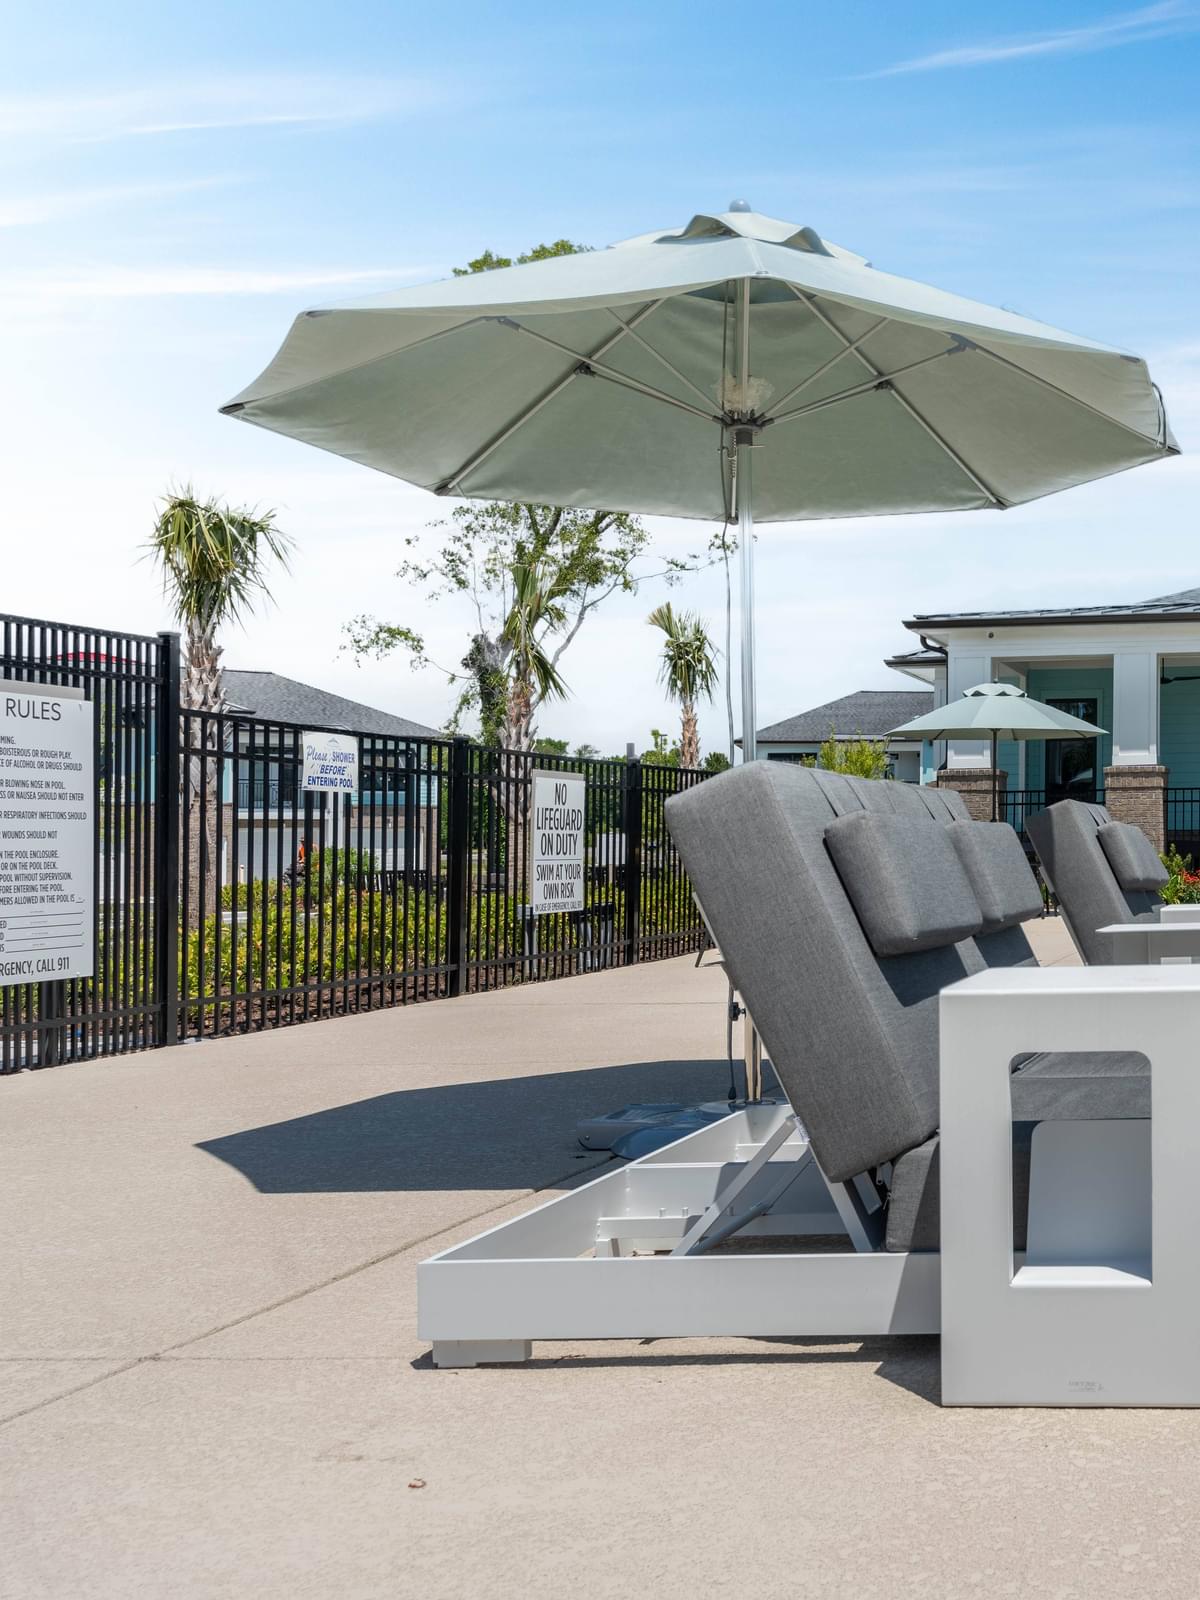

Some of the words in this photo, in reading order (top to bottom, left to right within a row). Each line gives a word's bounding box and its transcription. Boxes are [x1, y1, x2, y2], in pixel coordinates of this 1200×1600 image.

[6, 698, 61, 721] RULES
[32, 749, 39, 757] OR
[41, 750, 58, 759] ROUGH
[60, 751, 72, 759] PLAY.
[306, 745, 328, 761] Please
[332, 751, 355, 763] SHOWER
[6, 760, 12, 768] OF
[14, 760, 35, 769] ALCOHOL
[37, 761, 44, 769] OR
[46, 762, 61, 770] DRUGS
[63, 762, 82, 771] SHOULD
[320, 764, 347, 775] BEFORE
[5, 779, 29, 788] BLOWING
[31, 780, 43, 788] NOSE
[45, 781, 50, 789] IN
[52, 781, 66, 789] POOL.
[308, 776, 338, 787] ENTERING
[339, 777, 353, 788] POOL
[7, 791, 15, 799] OR
[16, 791, 36, 800] NAUSEA
[38, 792, 57, 800] SHOULD
[69, 793, 84, 801] ENTER
[554, 783, 567, 806] NO
[4, 811, 37, 819] RESPIRATORY
[39, 811, 66, 820] INFECTIONS
[68, 812, 87, 820] SHOULD
[536, 807, 583, 831] LIFEGUARD
[2, 831, 25, 839] WOUNDS
[27, 831, 46, 839] SHOULD
[48, 831, 57, 839] NOT
[540, 832, 554, 856] ON
[556, 833, 578, 856] DUTY
[4, 851, 13, 859] THE
[15, 851, 28, 859] POOL
[1, 862, 8, 870] OR
[10, 862, 17, 870] ON
[19, 862, 28, 870] THE
[30, 861, 42, 869] POOL
[15, 873, 37, 881] WITHOUT
[39, 872, 72, 880] SUPERVISION.
[536, 864, 555, 881] SWIM
[555, 864, 563, 880] AT
[564, 863, 581, 880] YOUR
[14, 884, 38, 893] ENTERING
[40, 884, 48, 892] THE
[543, 883, 560, 900] OWN
[560, 882, 575, 899] RISK
[15, 896, 38, 904] ALLOWED
[40, 896, 45, 904] IN
[47, 895, 55, 903] THE
[37, 958, 55, 972] CALL
[58, 956, 69, 970] 911
